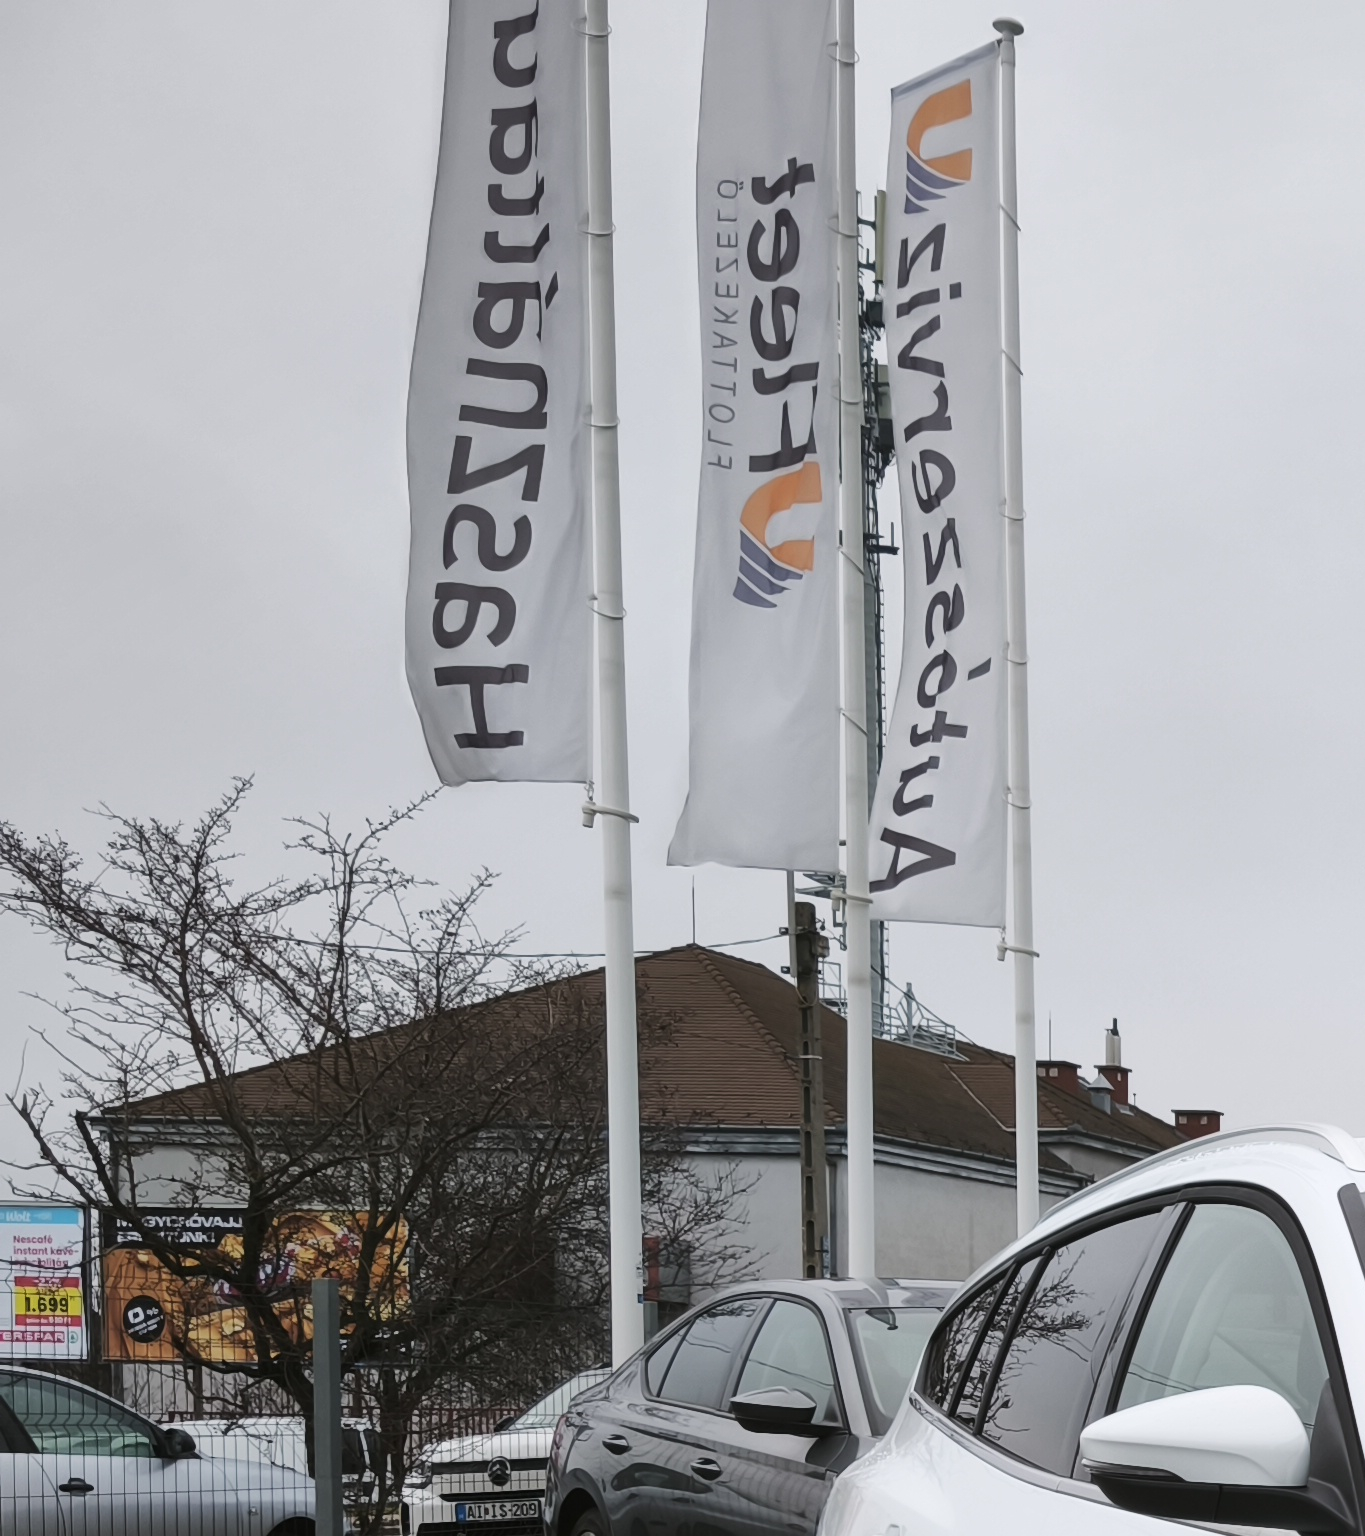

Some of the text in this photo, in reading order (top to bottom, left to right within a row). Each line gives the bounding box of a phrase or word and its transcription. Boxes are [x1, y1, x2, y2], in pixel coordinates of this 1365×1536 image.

[6, 1210, 32, 1223] Wolt
[13, 1234, 53, 1244] Nescafé
[13, 1245, 49, 1255] instant
[25, 1297, 68, 1312] 1.699
[0, 1331, 65, 1341] ERSPAR
